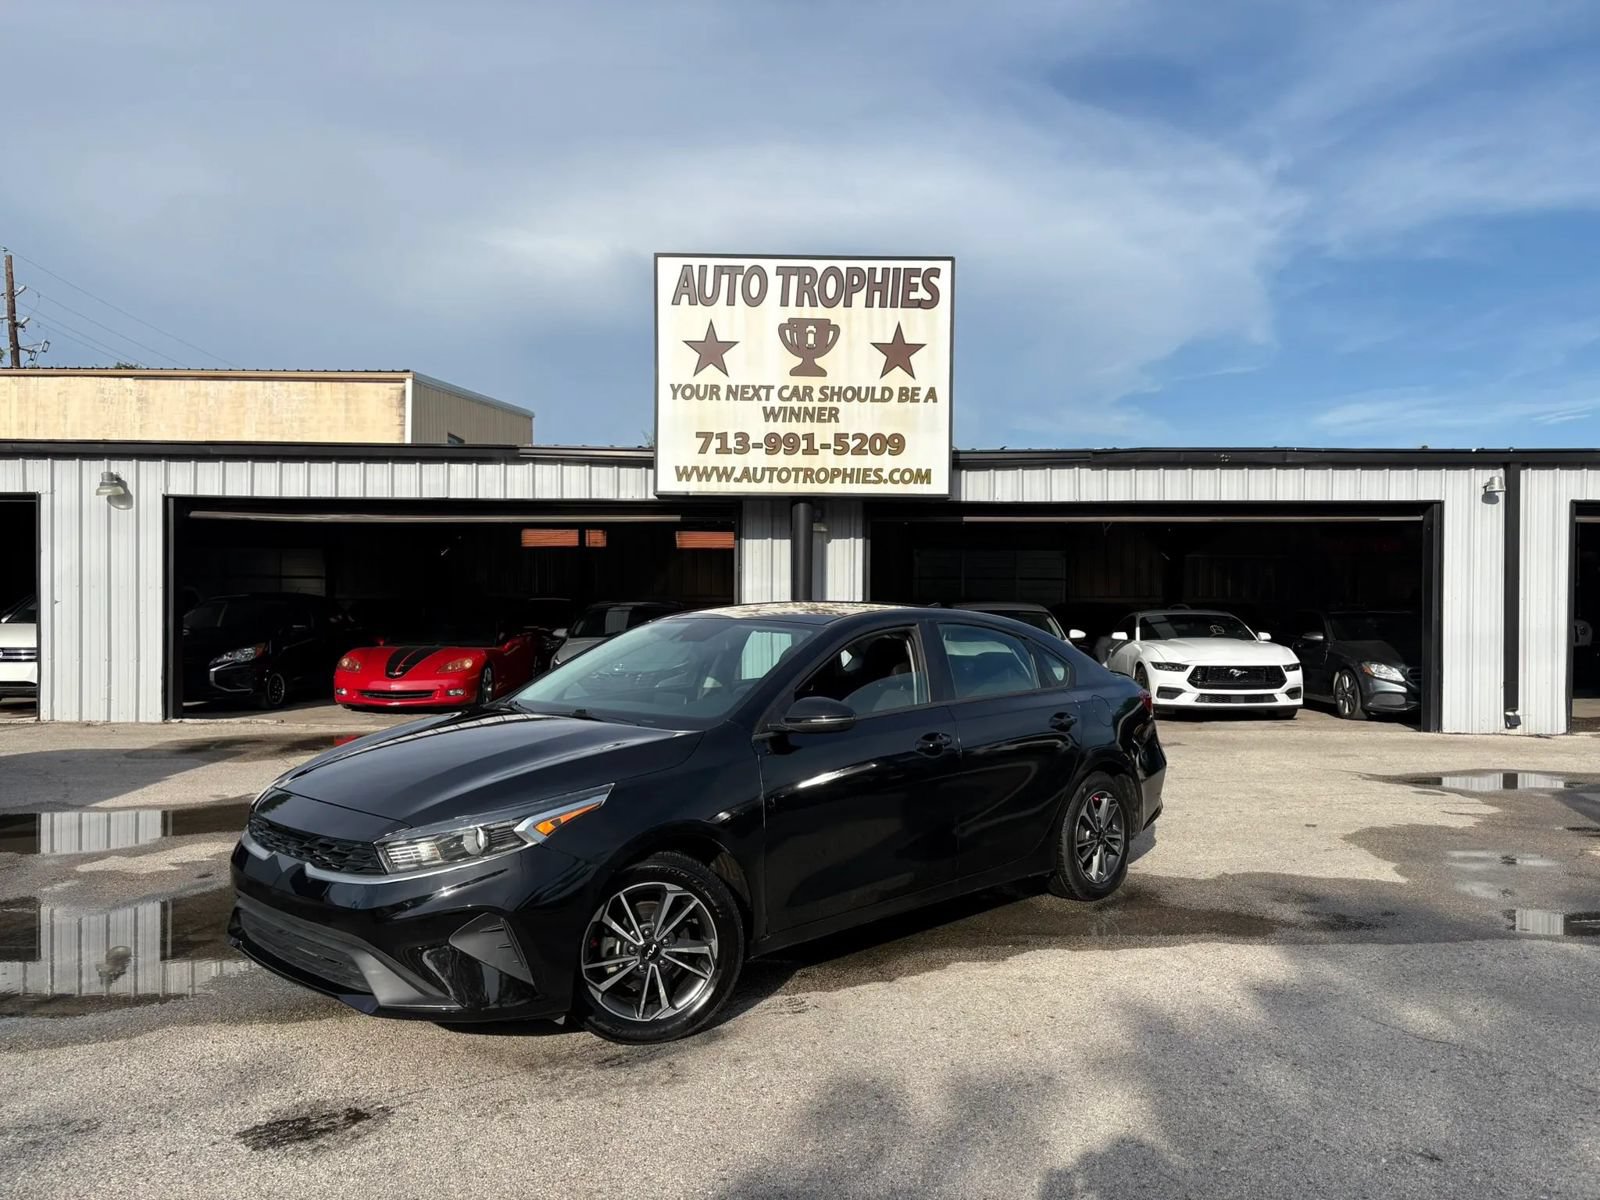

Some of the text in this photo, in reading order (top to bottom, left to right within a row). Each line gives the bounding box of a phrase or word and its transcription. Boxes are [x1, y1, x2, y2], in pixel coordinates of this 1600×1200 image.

[671, 265, 941, 310] AUTO TROPHIES
[670, 384, 938, 403] YOUR NEXT CAR SHOULD BE A
[762, 406, 840, 423] WINNER
[695, 431, 906, 456] 713-991-5209
[675, 465, 932, 485] WWW.AUTOTROPHIES.COM
